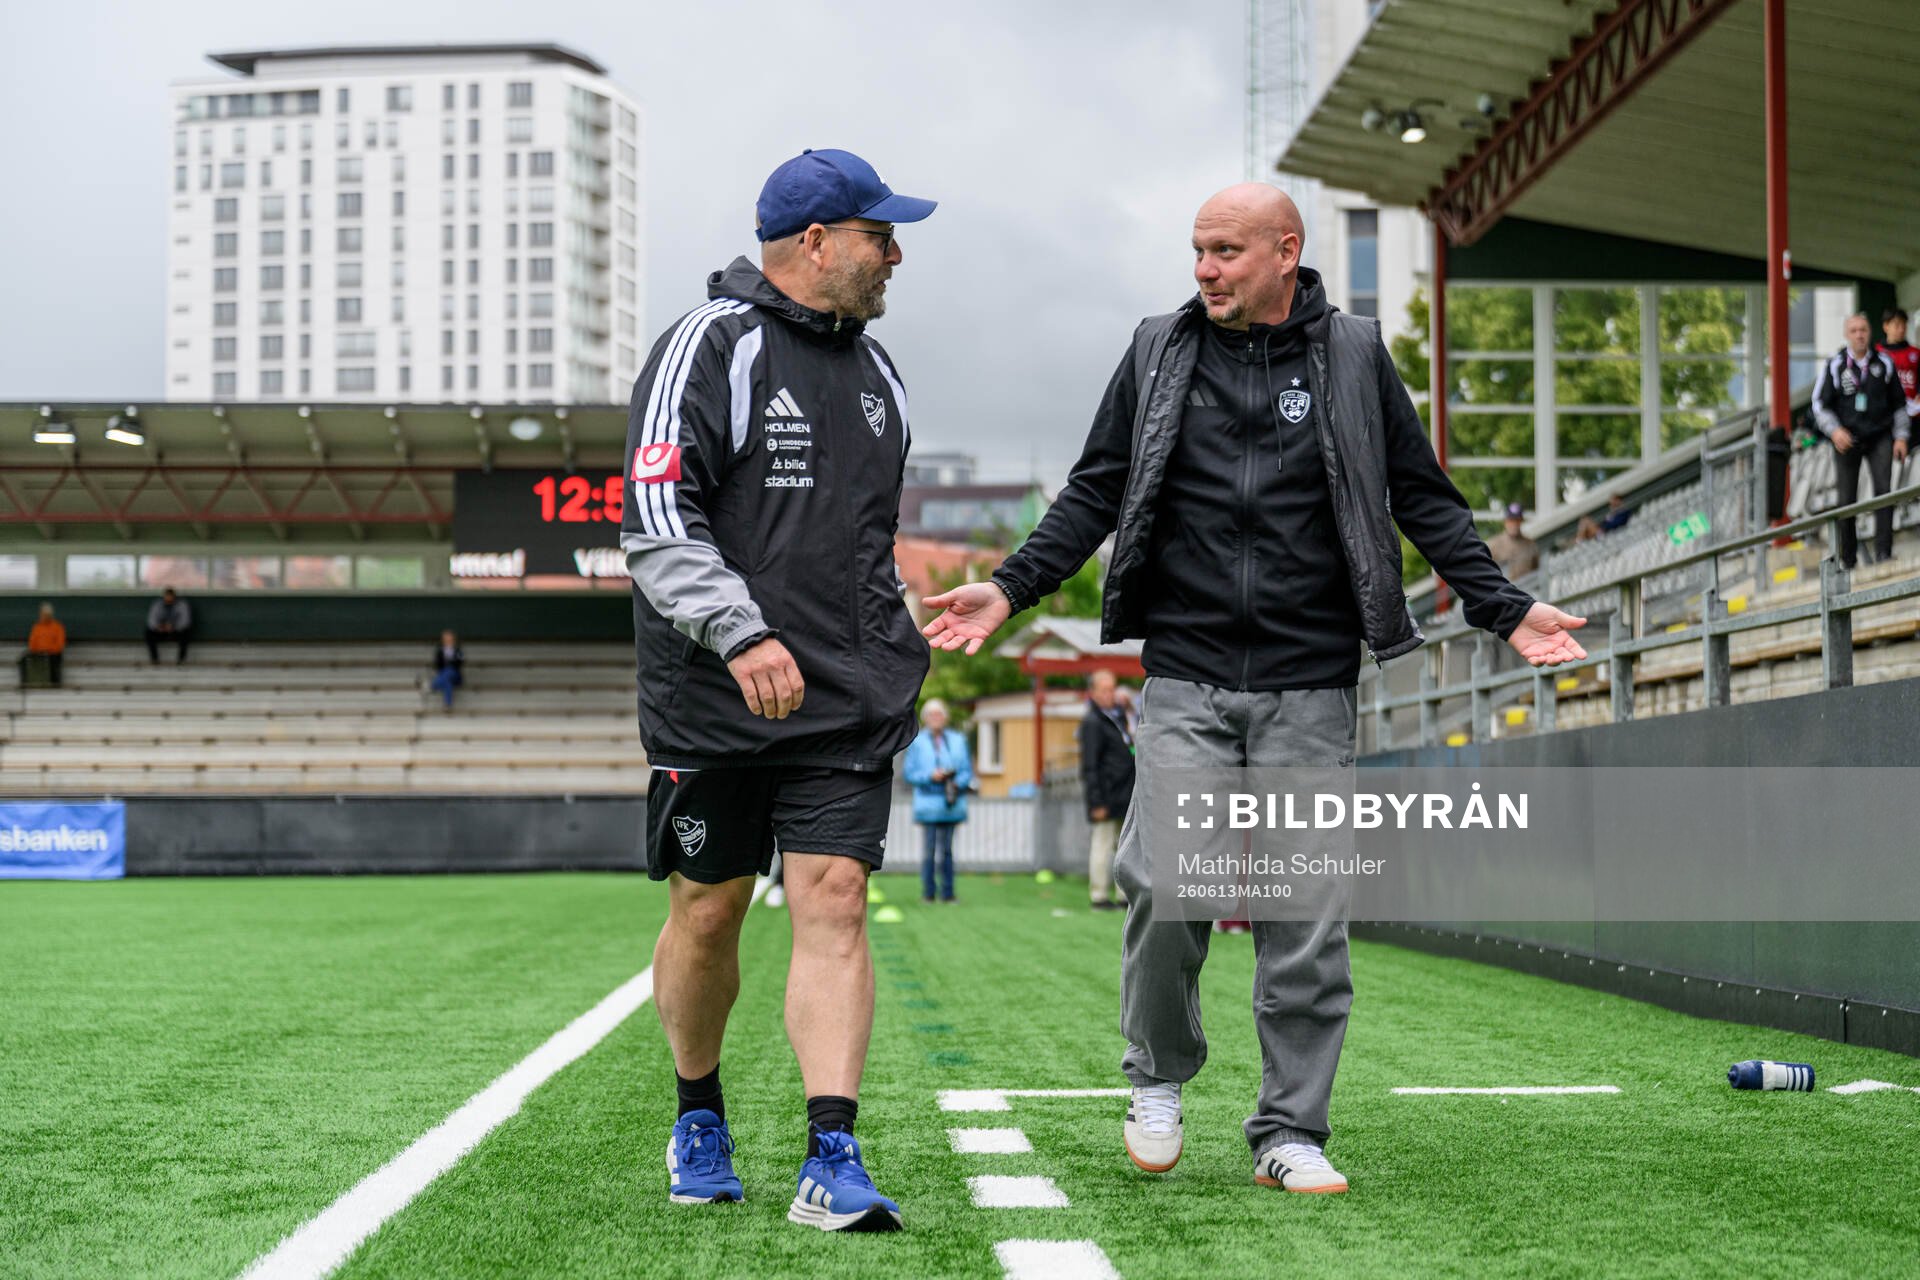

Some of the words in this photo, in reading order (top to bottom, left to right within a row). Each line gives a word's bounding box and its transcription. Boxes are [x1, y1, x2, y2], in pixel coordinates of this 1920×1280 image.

[1283, 399, 1305, 408] FCR
[765, 423, 810, 432] HOLMEN
[765, 475, 813, 487] stadium
[677, 820, 689, 830] IFK
[0, 823, 107, 852] sbanken
